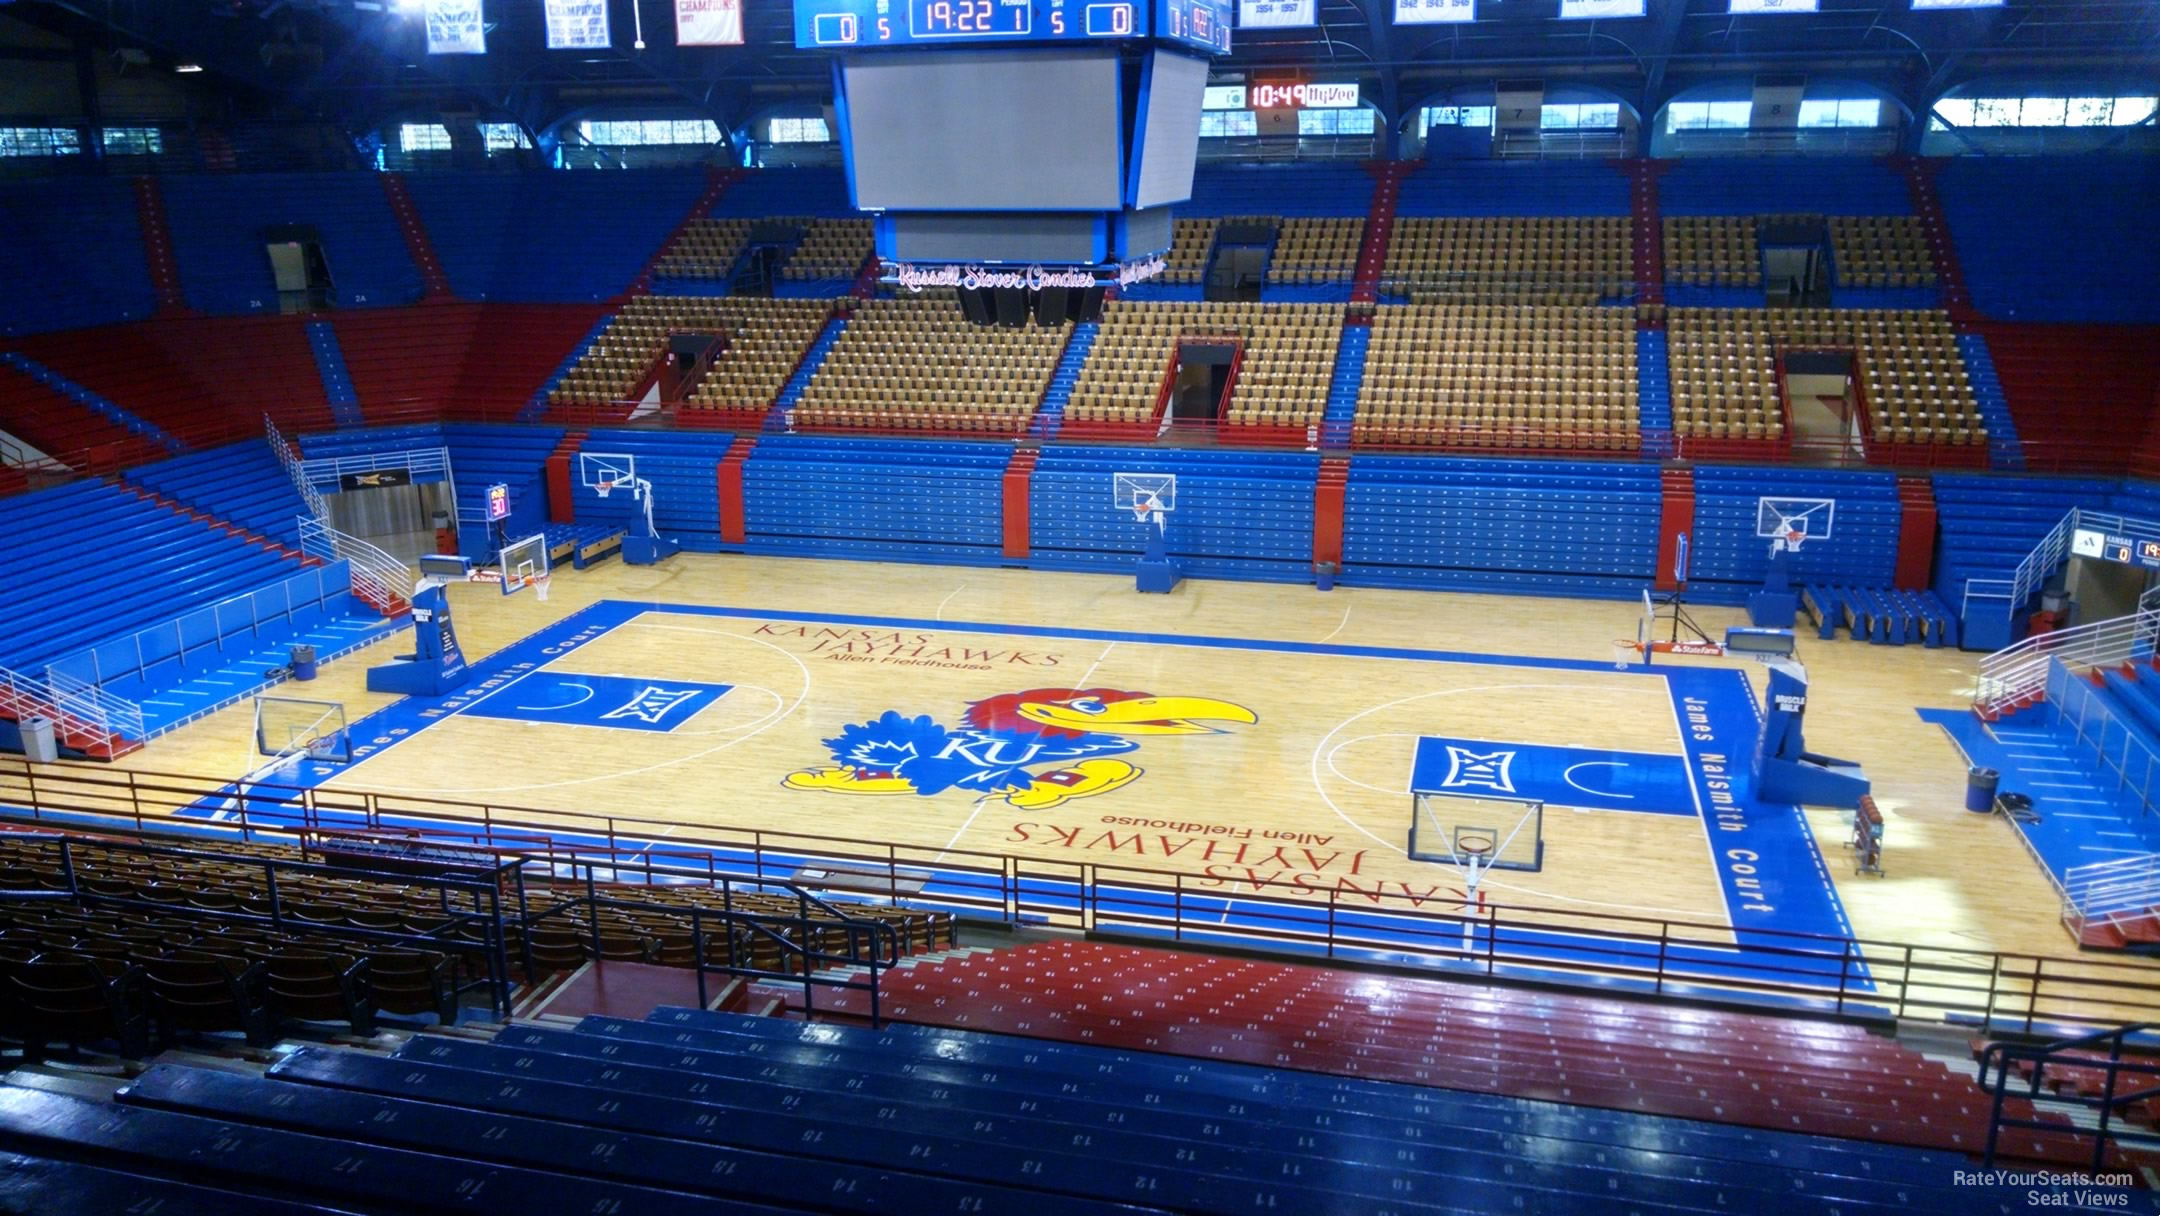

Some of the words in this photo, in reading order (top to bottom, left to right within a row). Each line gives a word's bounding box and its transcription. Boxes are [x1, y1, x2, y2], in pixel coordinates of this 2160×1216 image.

[926, 1, 993, 31] 19:22
[1015, 8, 1021, 30] 1
[1051, 11, 1064, 34] 5
[1112, 7, 1127, 33] 0
[840, 17, 854, 41] 0
[877, 18, 890, 40] 5
[1253, 84, 1307, 107] 10:49
[899, 261, 962, 292] Russell
[963, 261, 1024, 290] Stover
[1026, 261, 1096, 291] Candies
[2106, 535, 2133, 547] KANSAS
[2119, 548, 2128, 561] 0
[753, 623, 934, 646] KANSAS
[808, 640, 1065, 666] JAYHAWKS
[823, 652, 876, 664] Allen
[881, 655, 993, 671] Fieldhouse
[418, 661, 536, 718] Naismith
[541, 623, 607, 655] Court
[1775, 694, 1806, 705] MUSCLE
[930, 737, 1047, 767] KU
[1684, 697, 1714, 741] James
[1699, 753, 1748, 832] Naismith
[1727, 849, 1774, 912] Court
[1100, 814, 1256, 838] Fieldhouse
[1262, 828, 1335, 846] Allen
[1006, 822, 1369, 876] JAYHAWKS
[1200, 864, 1487, 915] KANSAS
[878, 1037, 893, 1045] 17
[760, 1068, 777, 1076] 17
[689, 1083, 708, 1093] 17
[1135, 1176, 1156, 1190] 12
